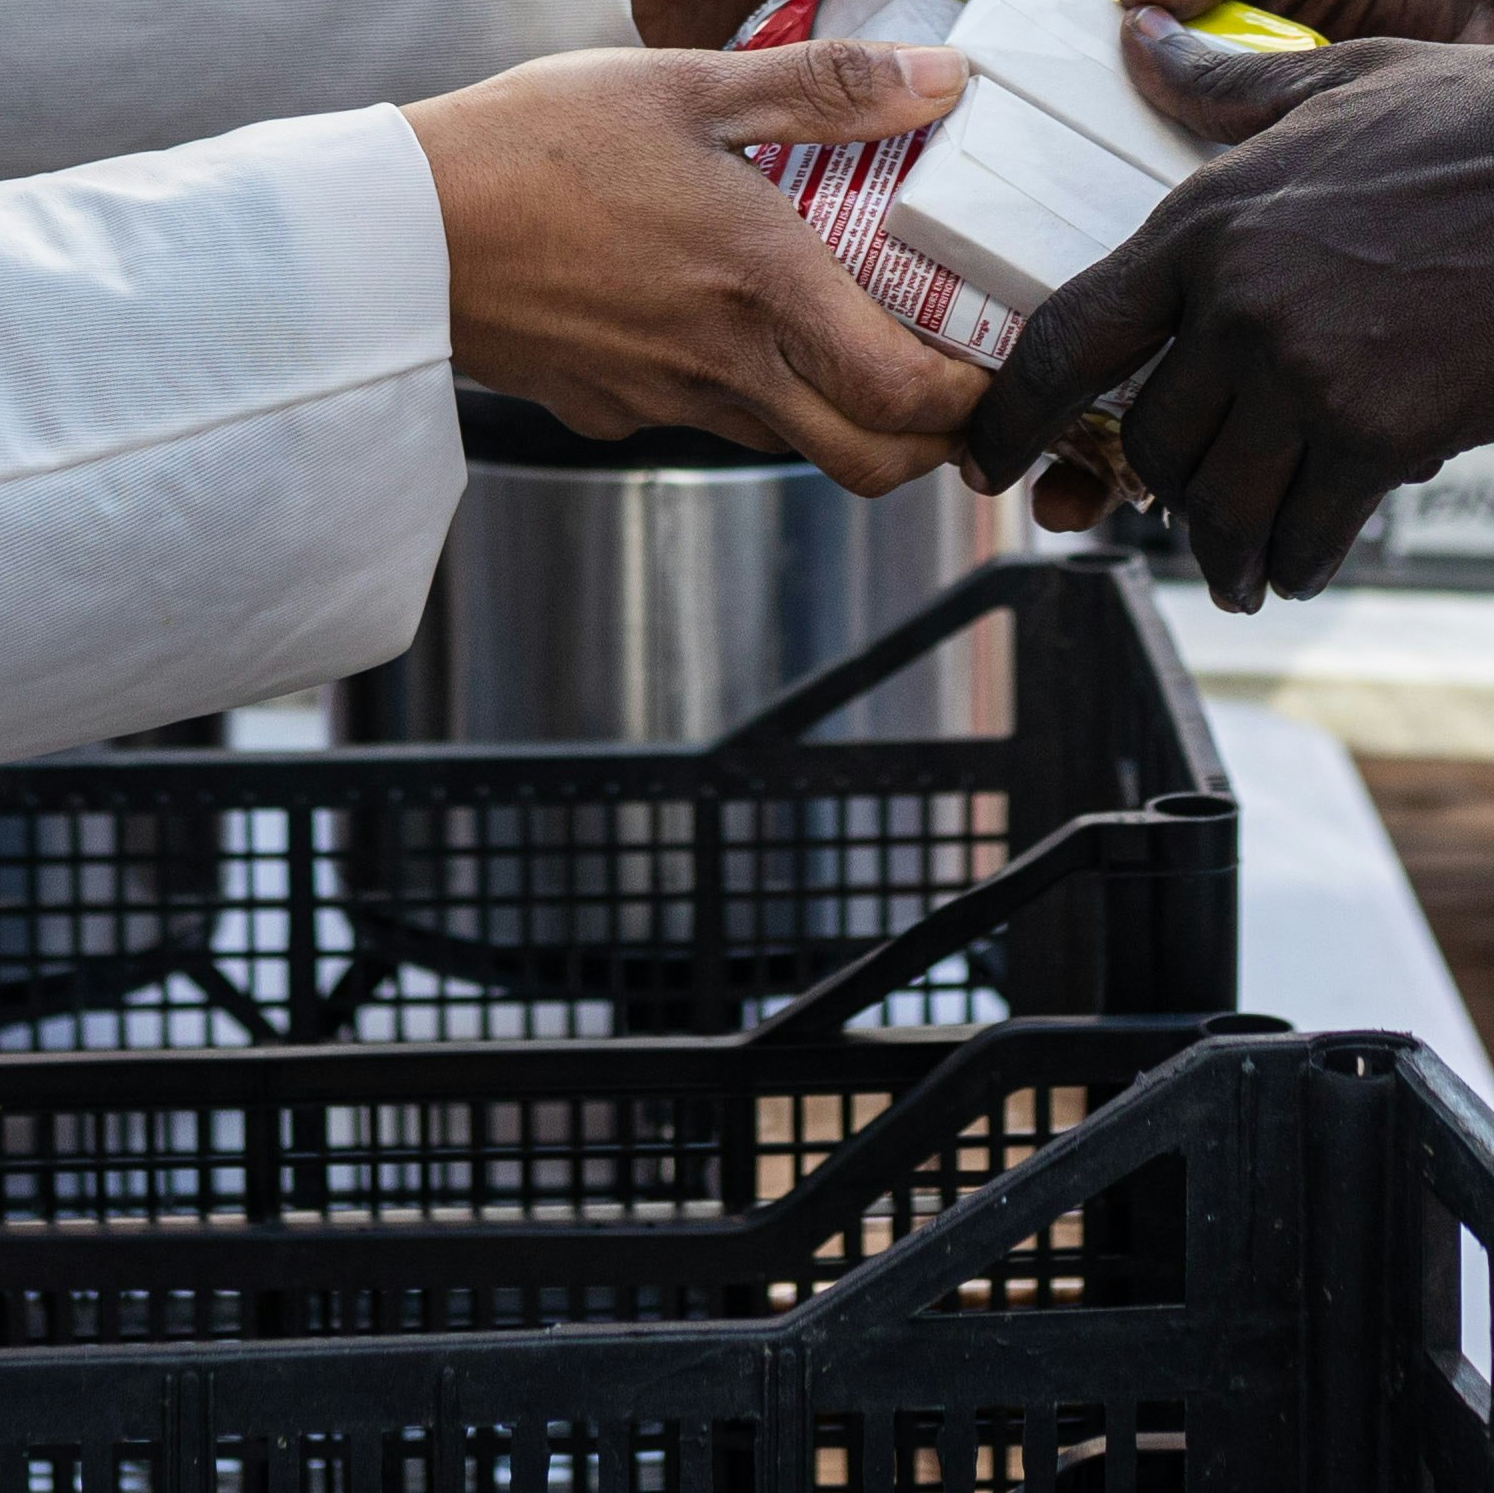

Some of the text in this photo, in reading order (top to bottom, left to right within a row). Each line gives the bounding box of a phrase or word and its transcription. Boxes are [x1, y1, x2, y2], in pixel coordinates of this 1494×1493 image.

[829, 180, 843, 198] fruits
[825, 197, 836, 209] de
[871, 195, 882, 207] les
[828, 188, 858, 244] D'UTILISATION
[867, 206, 877, 218] de
[847, 226, 858, 237] de
[871, 236, 884, 249] DE
[869, 251, 893, 295] consommer
[886, 239, 897, 251] de
[887, 291, 899, 302] de
[896, 288, 913, 309] jours
[906, 269, 920, 289] pour
[903, 274, 928, 319] Conditionné
[918, 290, 940, 326] VALEURS
[928, 318, 940, 329] ET
[969, 317, 992, 348] Énergie
[995, 324, 1015, 357] Matières
